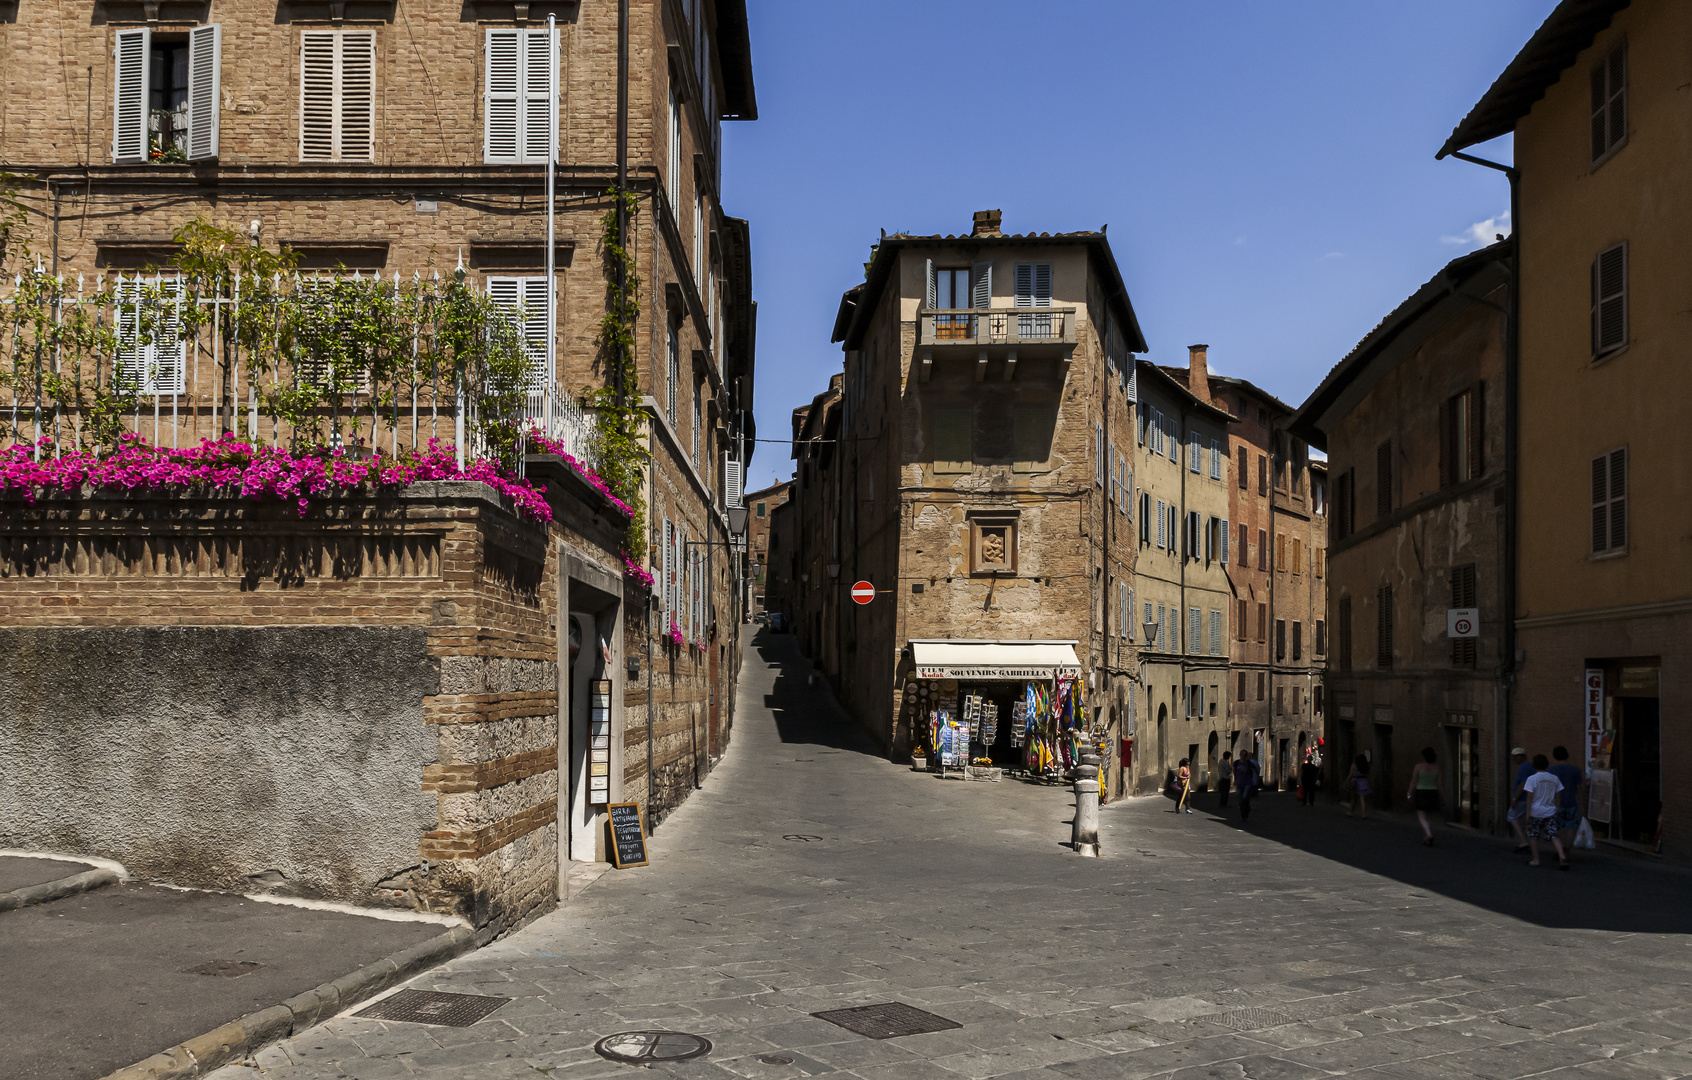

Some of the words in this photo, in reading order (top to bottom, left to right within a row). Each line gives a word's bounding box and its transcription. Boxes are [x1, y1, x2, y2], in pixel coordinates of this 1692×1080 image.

[949, 669, 997, 677] SOUVENIRS
[998, 669, 1047, 677] GABRIELLA
[1451, 714, 1474, 724] BAR
[1588, 675, 1601, 758] GELATI
[611, 808, 630, 816] BIRRA
